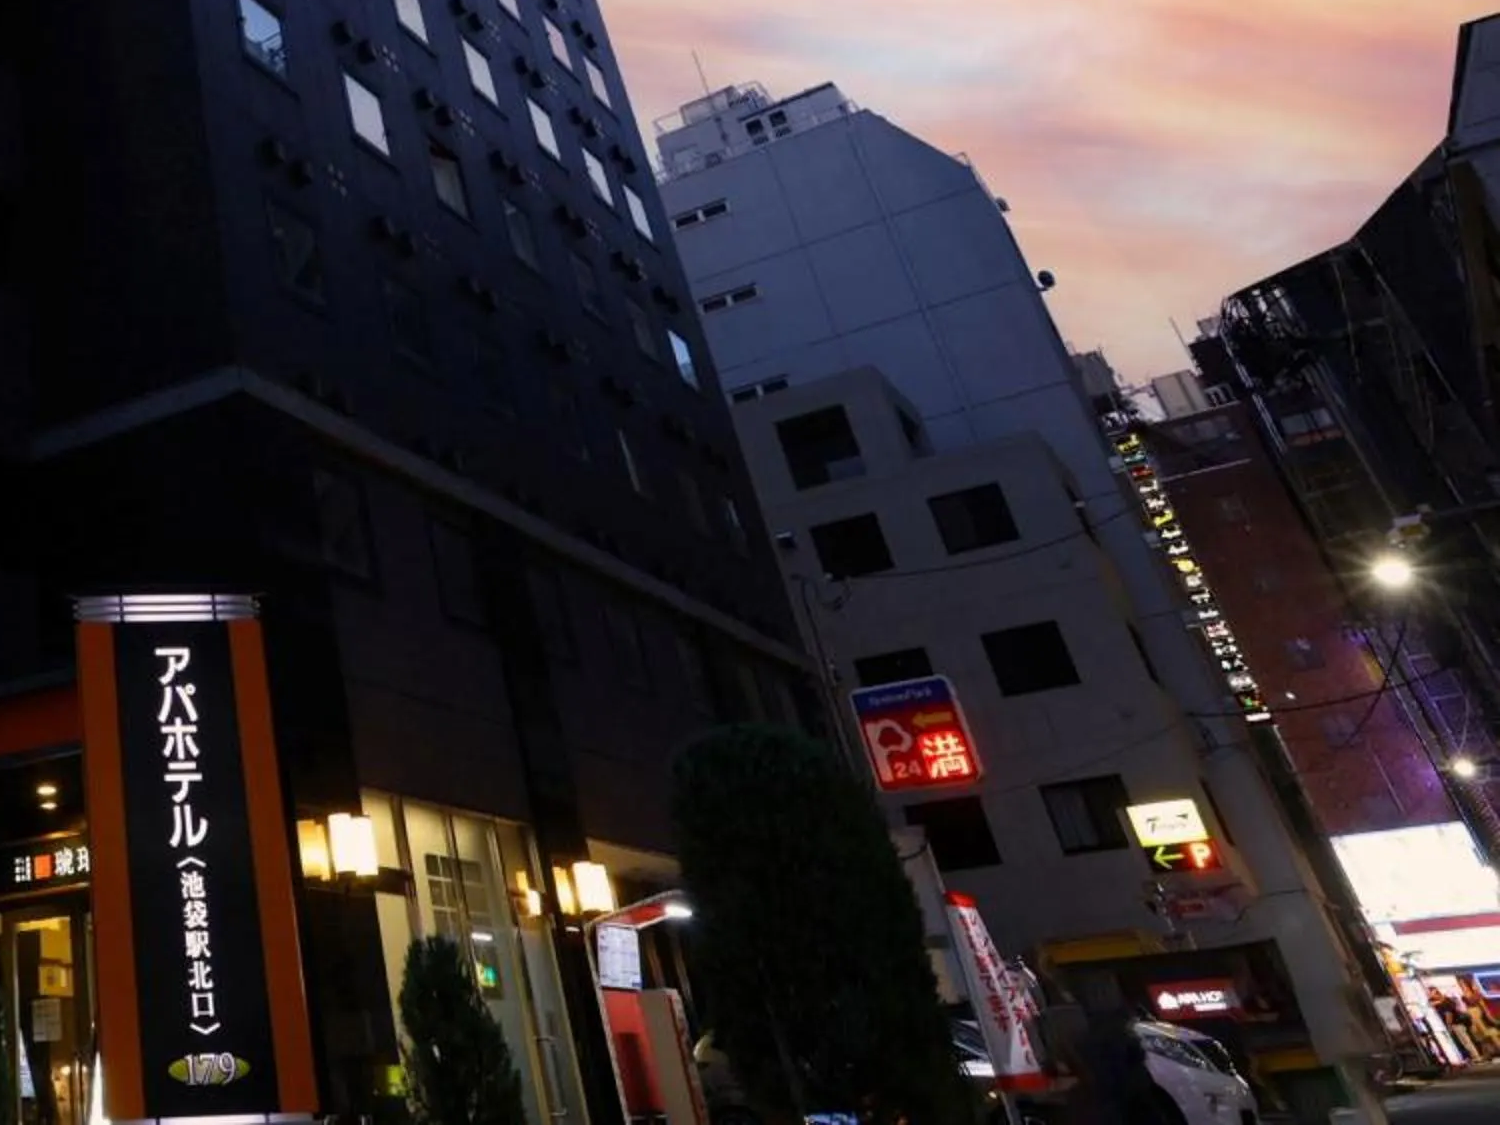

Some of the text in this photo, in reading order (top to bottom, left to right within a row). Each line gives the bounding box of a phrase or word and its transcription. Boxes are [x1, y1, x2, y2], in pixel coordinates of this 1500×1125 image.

[154, 647, 209, 848] アパホテル
[922, 730, 967, 779] 満
[1189, 841, 1212, 869] P
[184, 1052, 236, 1086] 179
